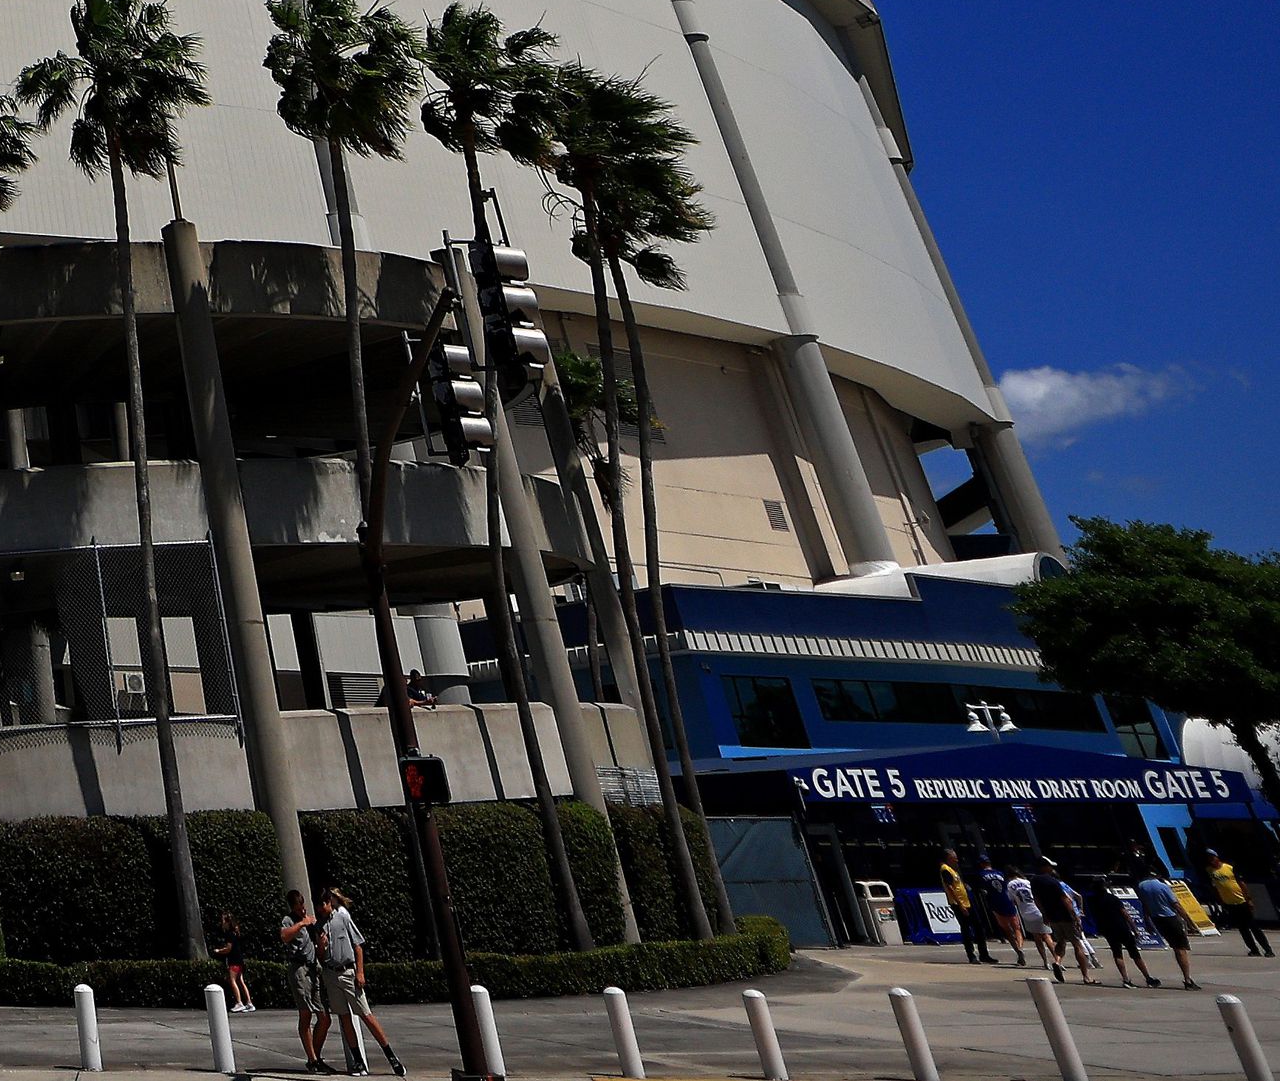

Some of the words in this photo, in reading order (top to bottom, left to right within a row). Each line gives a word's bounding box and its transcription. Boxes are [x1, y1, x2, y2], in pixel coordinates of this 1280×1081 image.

[812, 768, 884, 799] GATE
[887, 768, 906, 799] 5
[913, 778, 990, 799] REPUBLIC
[990, 779, 1039, 799] BANK
[1036, 779, 1090, 799] DRAFT
[1090, 779, 1145, 799] ROOM
[1144, 770, 1212, 799] GATE
[1210, 770, 1230, 799] 5
